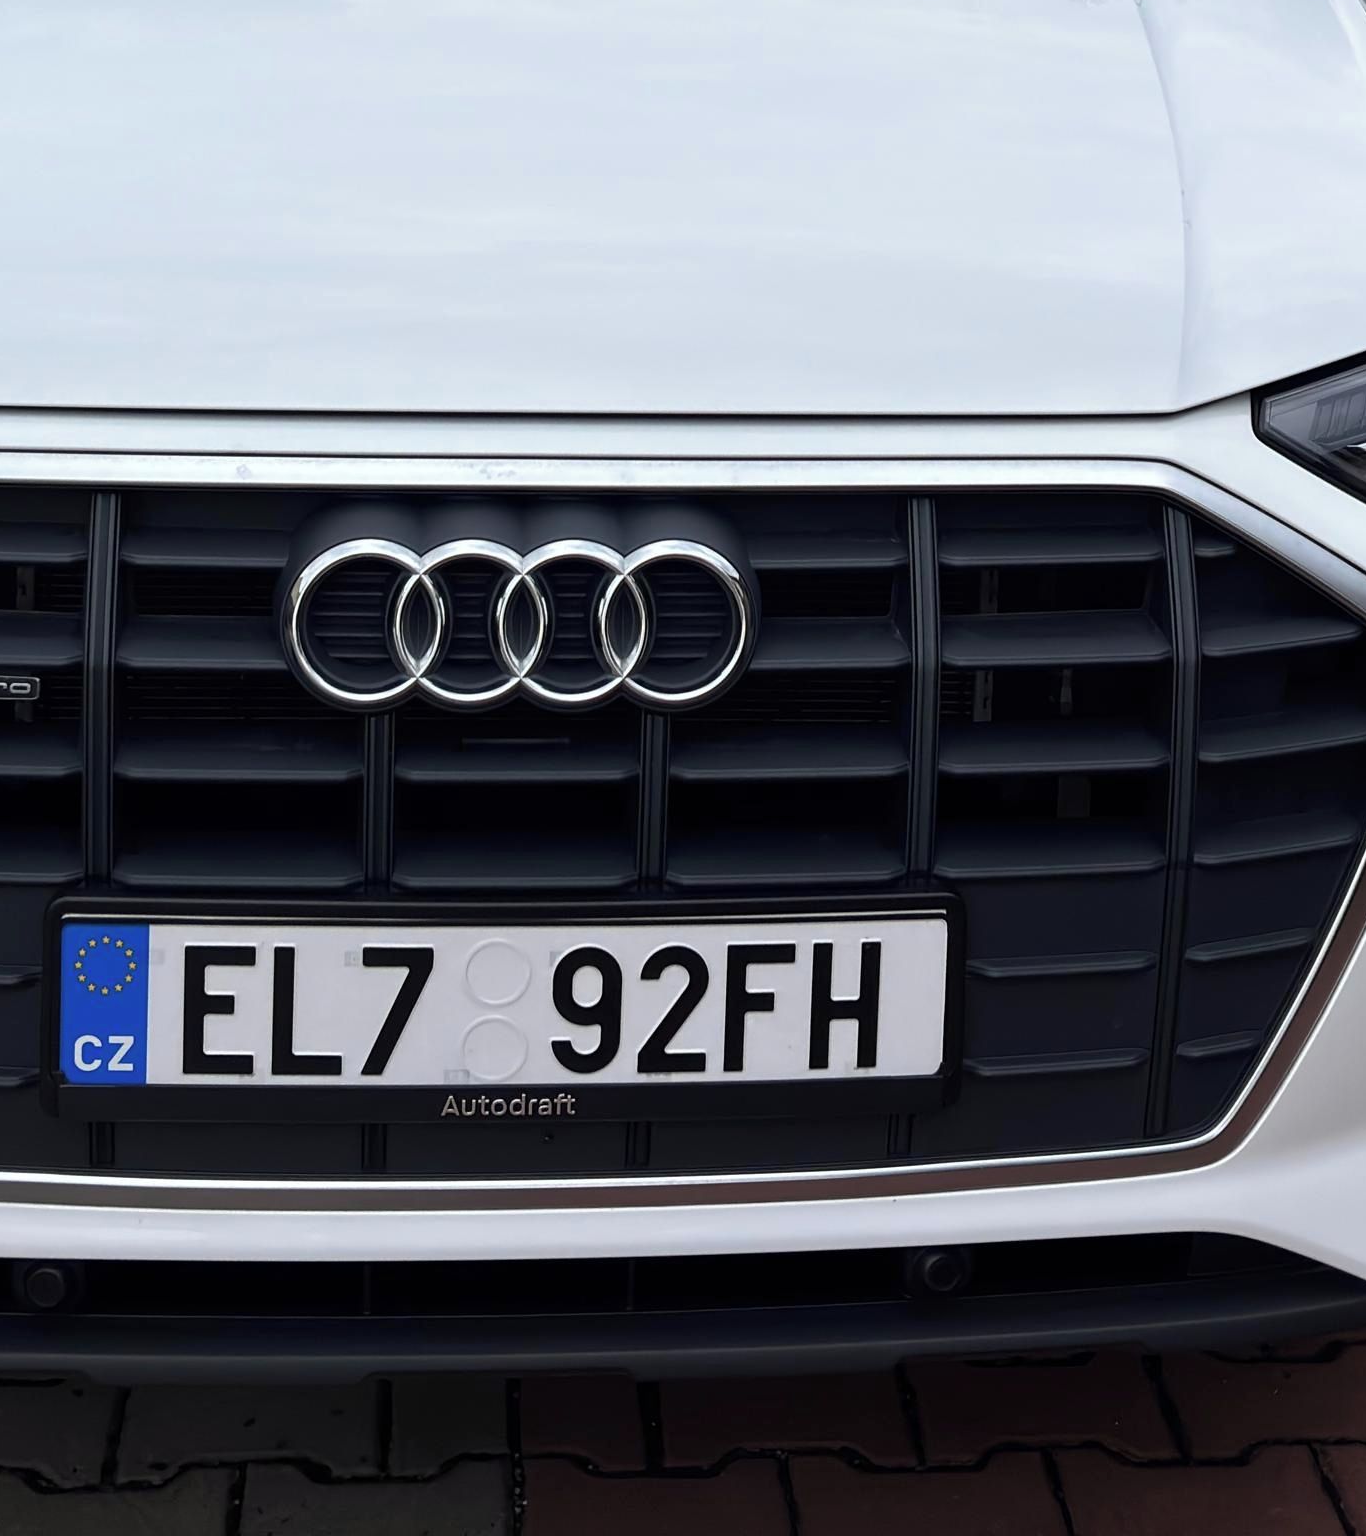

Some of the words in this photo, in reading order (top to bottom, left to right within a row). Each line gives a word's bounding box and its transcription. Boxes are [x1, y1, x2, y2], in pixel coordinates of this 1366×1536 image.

[182, 944, 435, 1076] EL7
[550, 939, 882, 1075] 92FH
[73, 1034, 135, 1072] CZ
[440, 1092, 576, 1117] Autodraft
